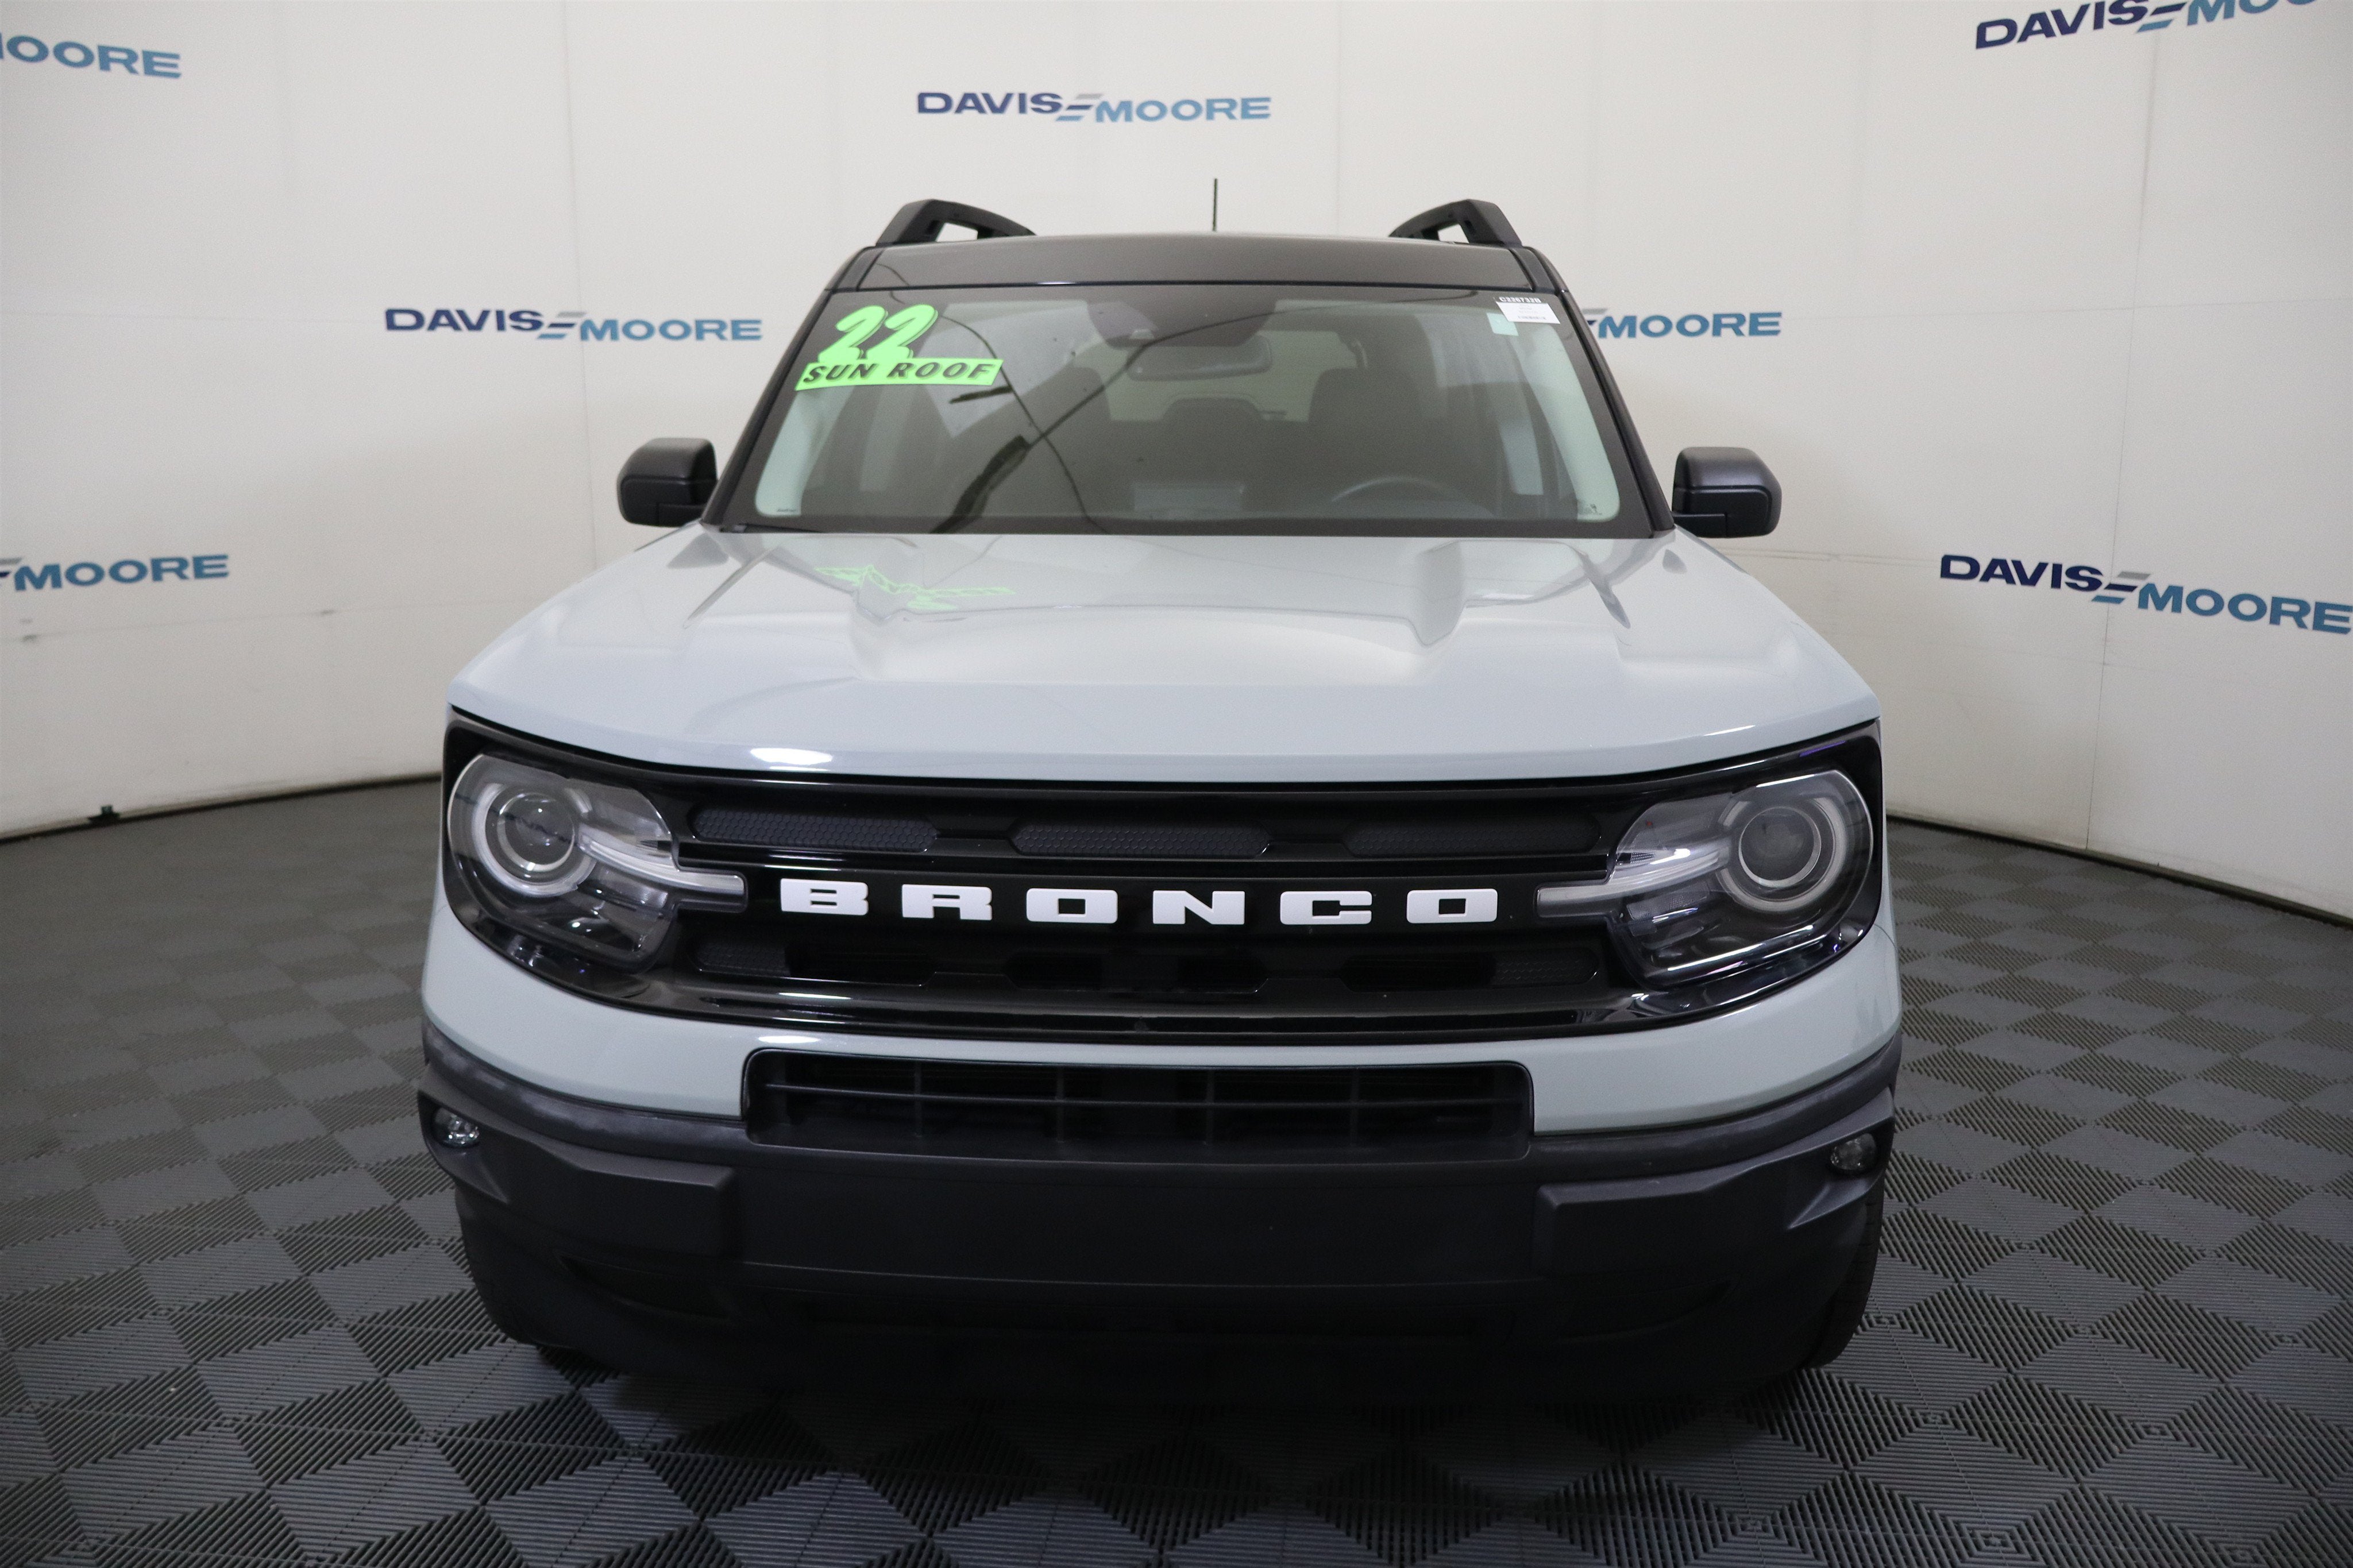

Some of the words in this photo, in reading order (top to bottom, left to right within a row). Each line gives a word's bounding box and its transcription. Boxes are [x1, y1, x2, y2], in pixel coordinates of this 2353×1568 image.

[1976, 0, 2148, 49] DAVIS
[0, 33, 182, 79] OORE
[917, 92, 1063, 114] DAVIS
[1095, 96, 1272, 123] MOORE
[385, 308, 543, 331] DAVIS
[580, 319, 763, 341] MOORE
[818, 304, 938, 362] 22
[1598, 311, 1782, 339] MOORE
[803, 363, 878, 383] SUN
[887, 362, 996, 379] ROOF
[14, 554, 229, 591] MOORE
[1941, 554, 2103, 592] DAVIS
[2138, 582, 2353, 635] MOORE
[780, 878, 1498, 925] BRONCO
